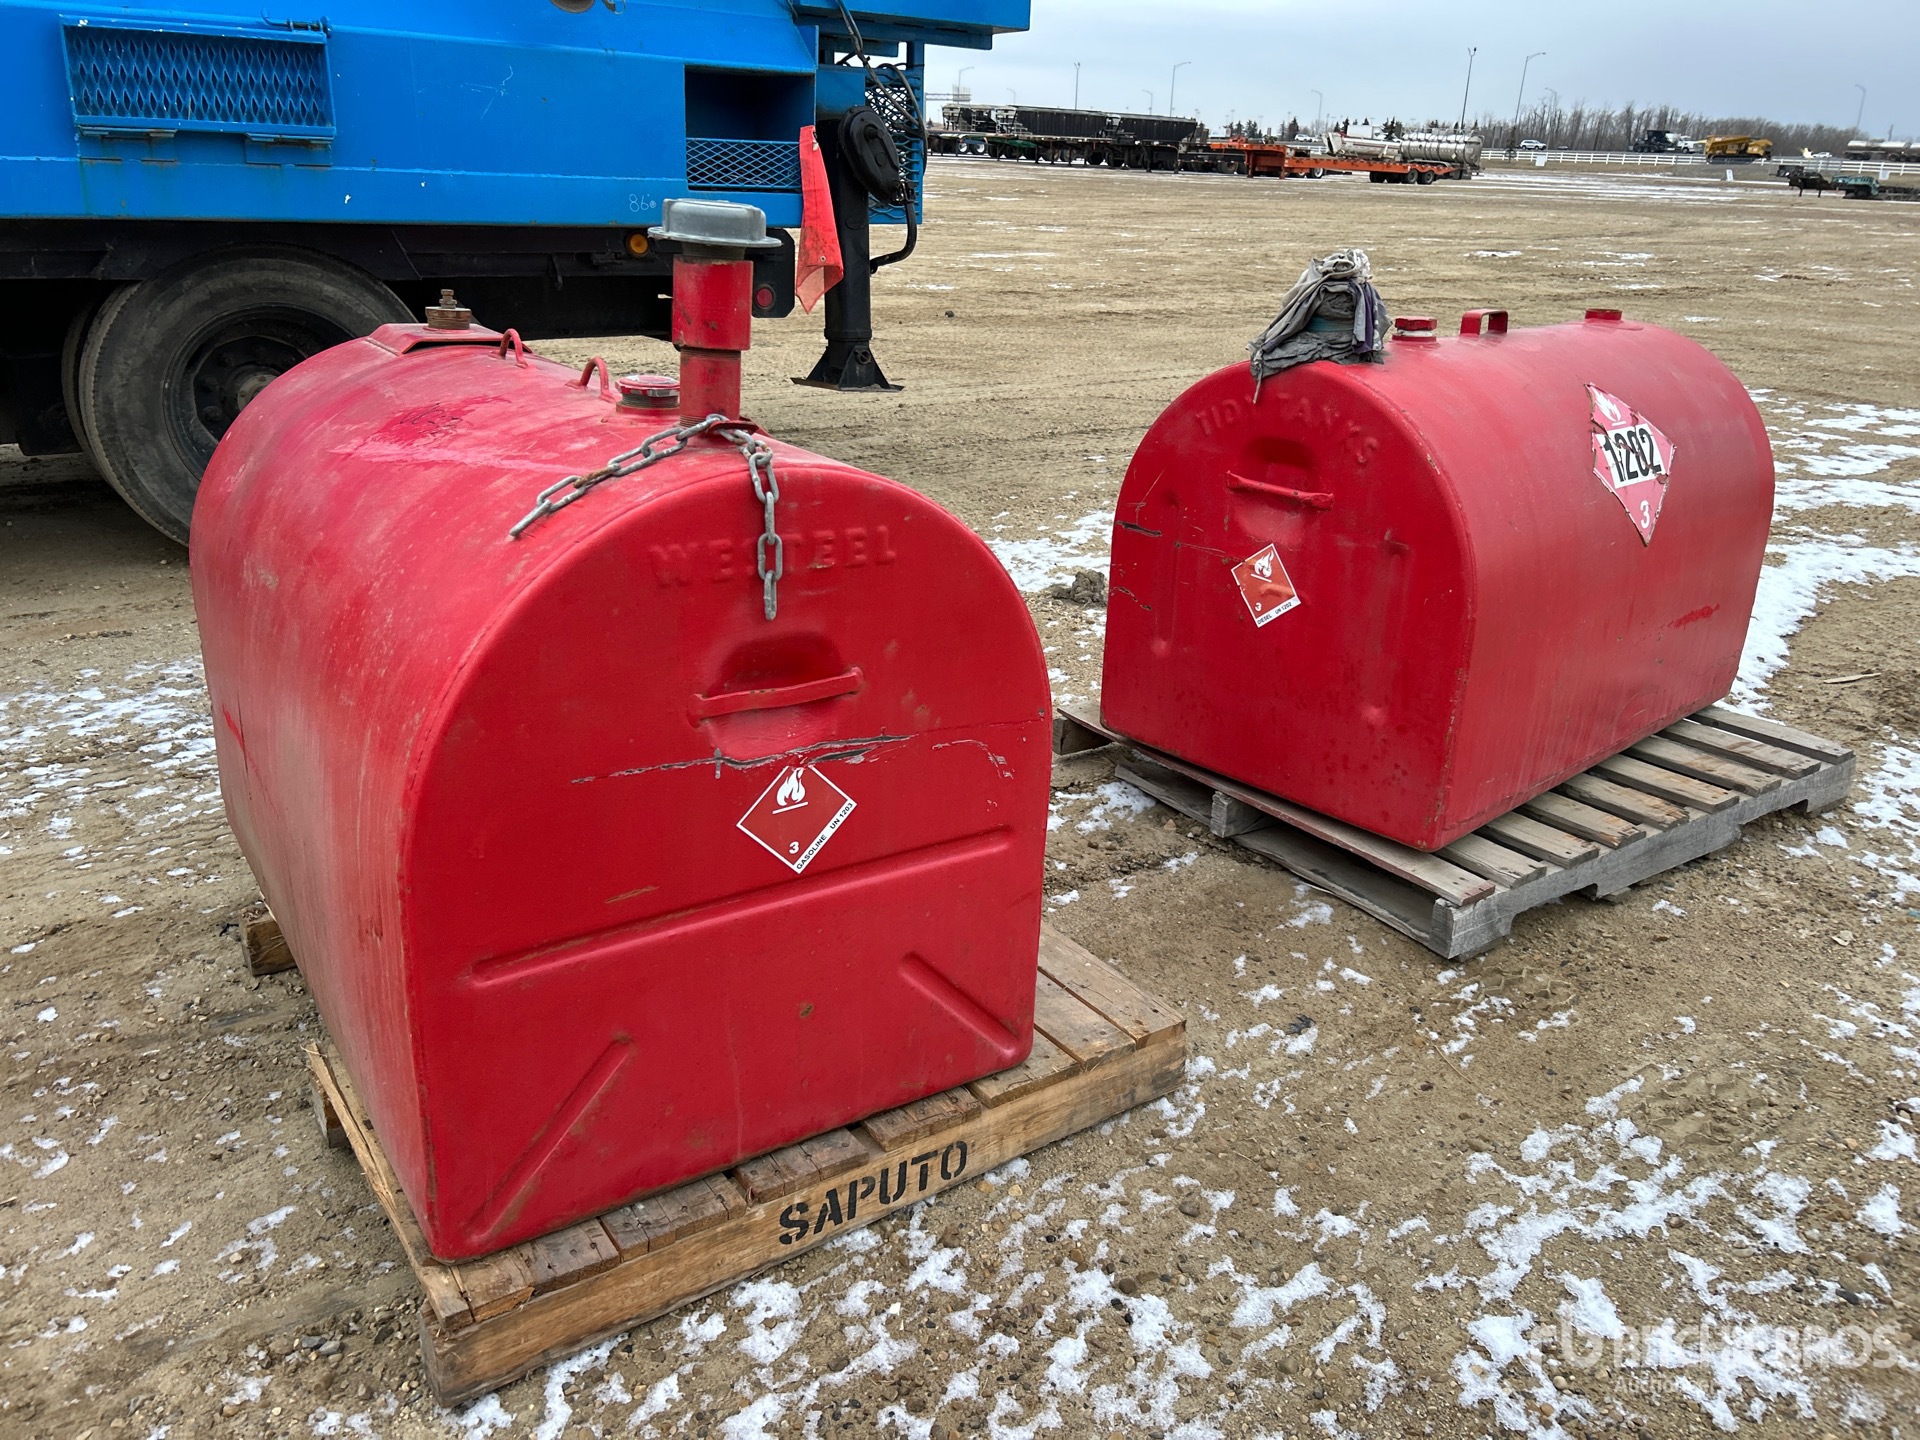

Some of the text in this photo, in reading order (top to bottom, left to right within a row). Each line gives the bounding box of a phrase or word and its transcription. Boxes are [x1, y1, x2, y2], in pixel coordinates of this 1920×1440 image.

[1276, 392, 1380, 466] TANKS
[1603, 427, 1662, 483] 1202
[1640, 500, 1650, 529] 3
[1254, 602, 1262, 612] 3
[1257, 601, 1293, 625] DIESEL UN 1202
[788, 841, 800, 855] 3
[796, 802, 853, 870] GASOLINE UN 1203
[778, 1140, 968, 1245] SAPUTO
